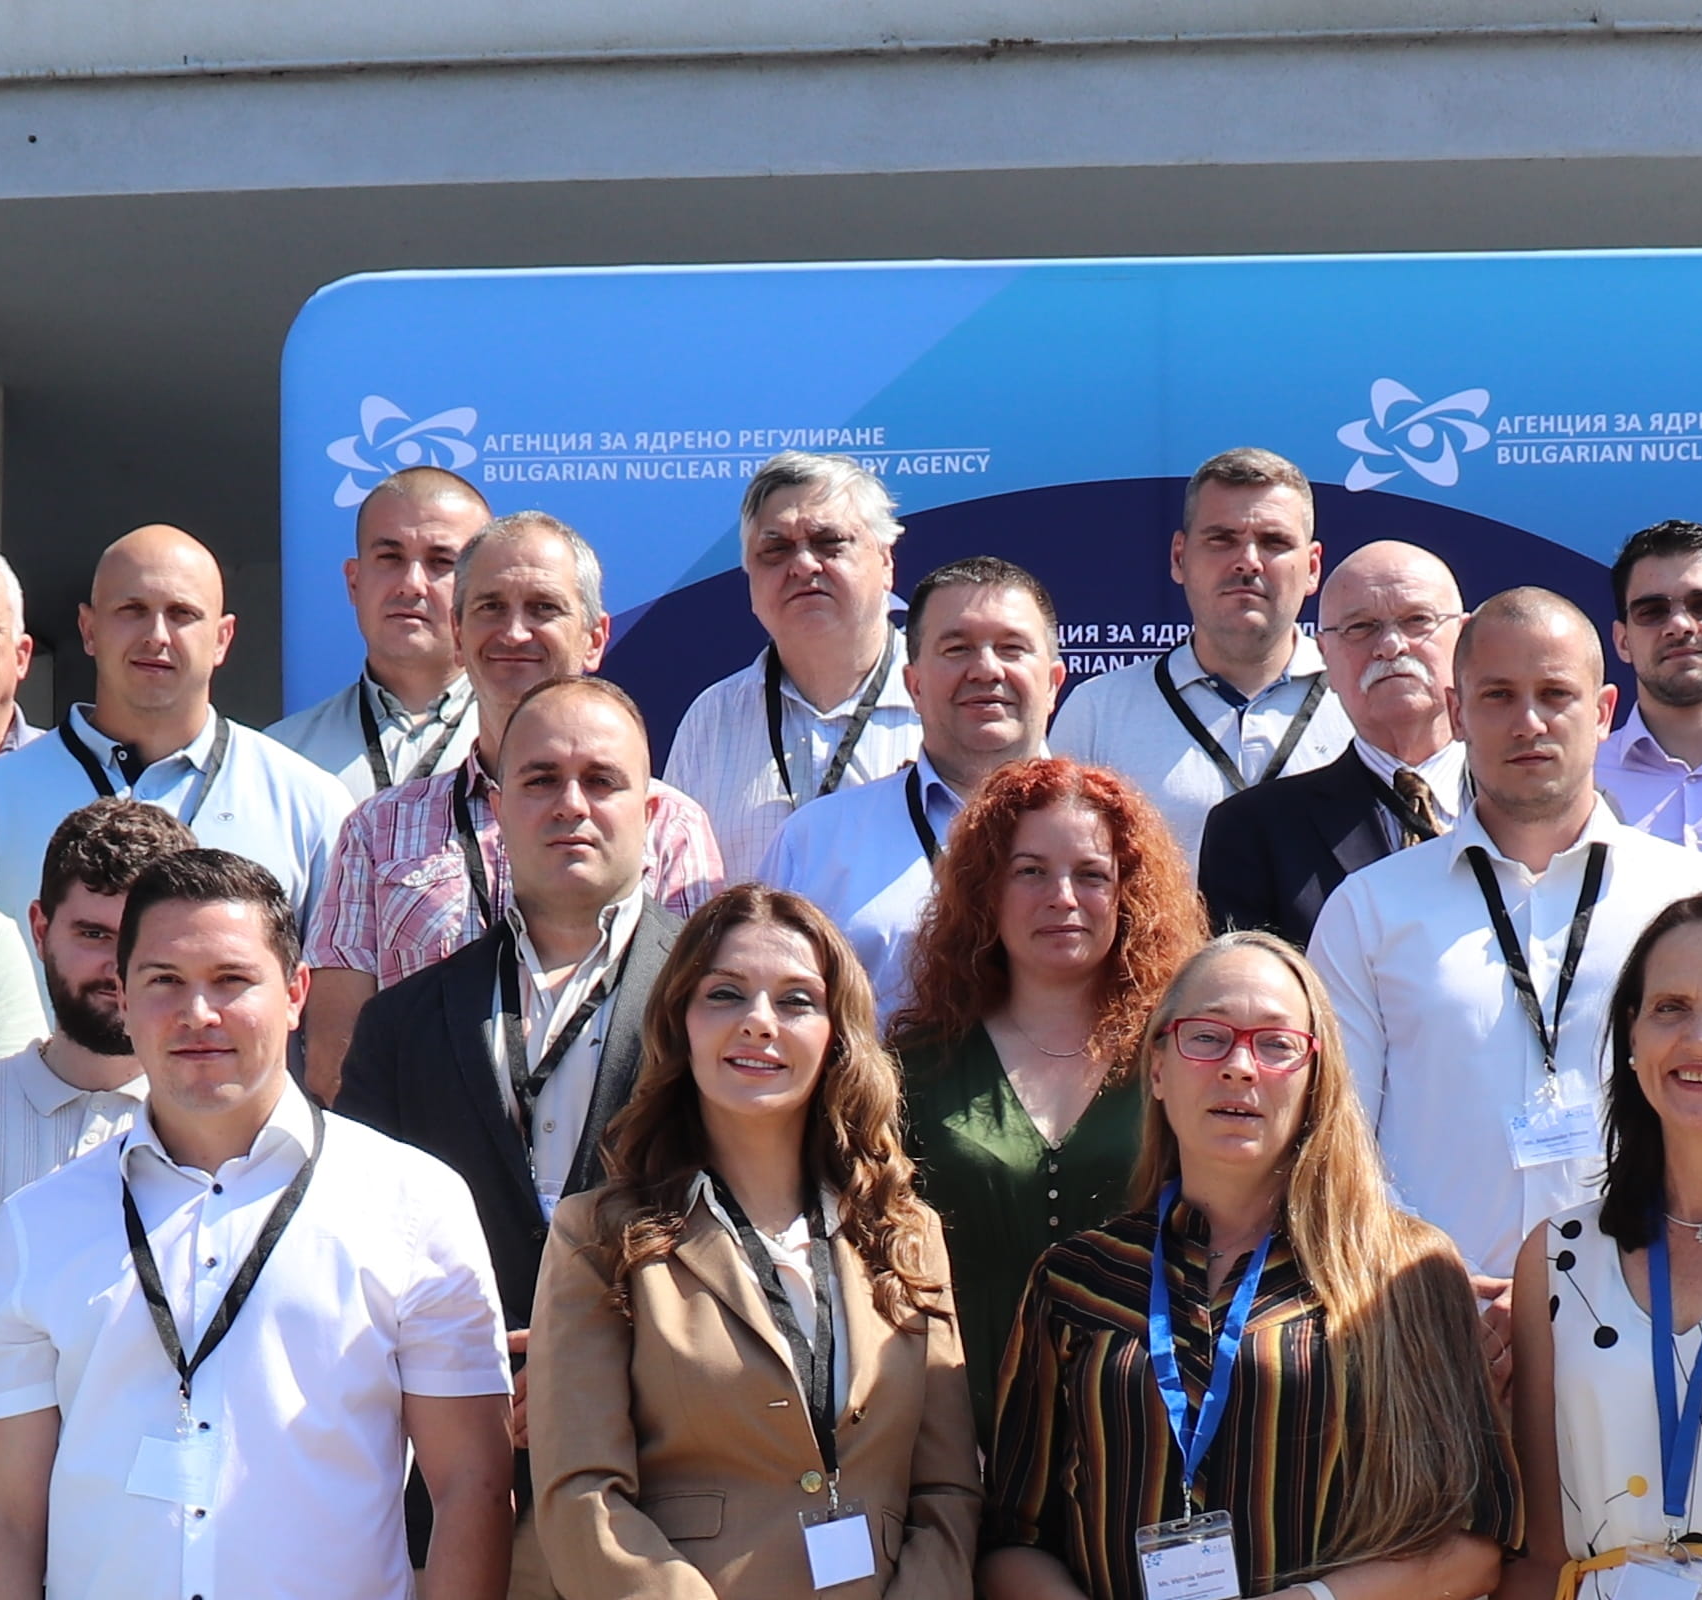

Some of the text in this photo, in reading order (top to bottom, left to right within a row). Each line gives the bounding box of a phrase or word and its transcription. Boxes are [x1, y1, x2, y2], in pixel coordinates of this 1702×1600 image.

[1496, 413, 1607, 439] АГЕНЦИЯ
[1614, 413, 1643, 434] ЗА
[483, 426, 886, 455] АГЕНЦИЯ ЗА ЯДРЕНО РЕГУЛИРАНЕ
[896, 454, 992, 476] AGENCY
[1496, 442, 1633, 465] BULGARIAN
[483, 461, 618, 483] BULGARIAN
[625, 459, 733, 481] NUCLEAR
[1106, 624, 1135, 643] ЗА
[1141, 623, 1196, 647] ЯДР
